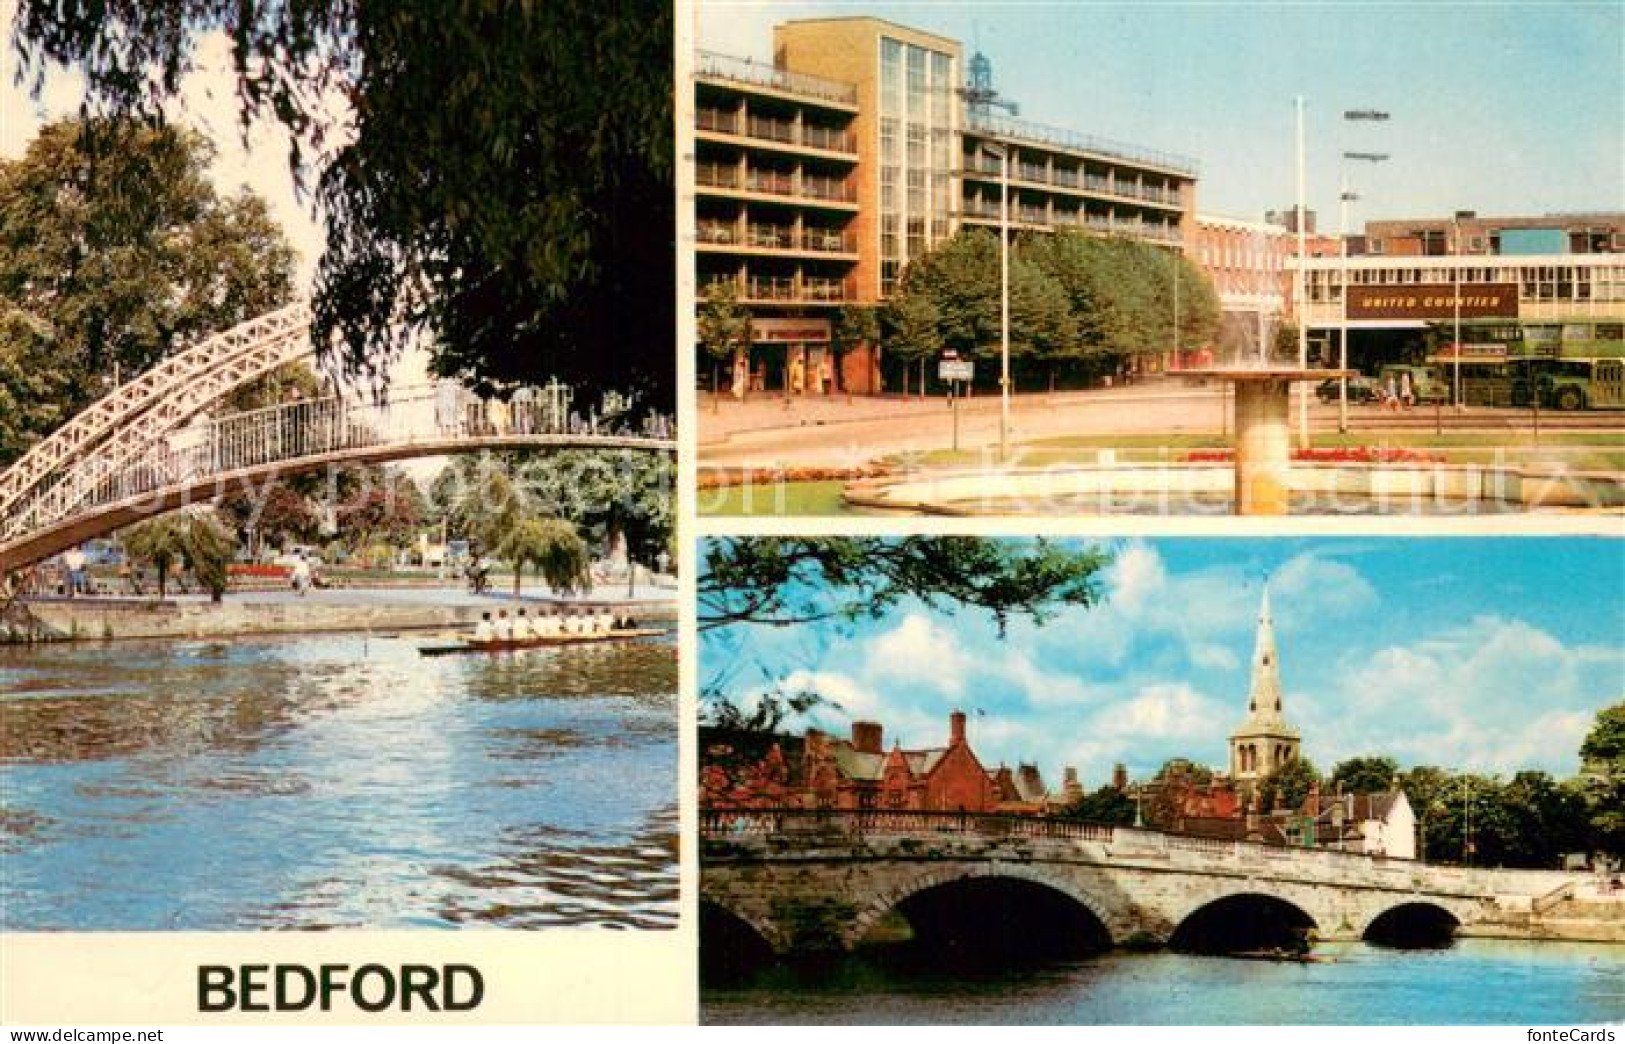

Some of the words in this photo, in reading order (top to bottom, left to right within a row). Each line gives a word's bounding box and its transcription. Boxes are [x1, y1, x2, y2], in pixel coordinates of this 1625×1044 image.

[1362, 296, 1415, 308] UNITED
[1423, 296, 1499, 308] COUNTIES
[199, 965, 483, 1012] BEDFORD
